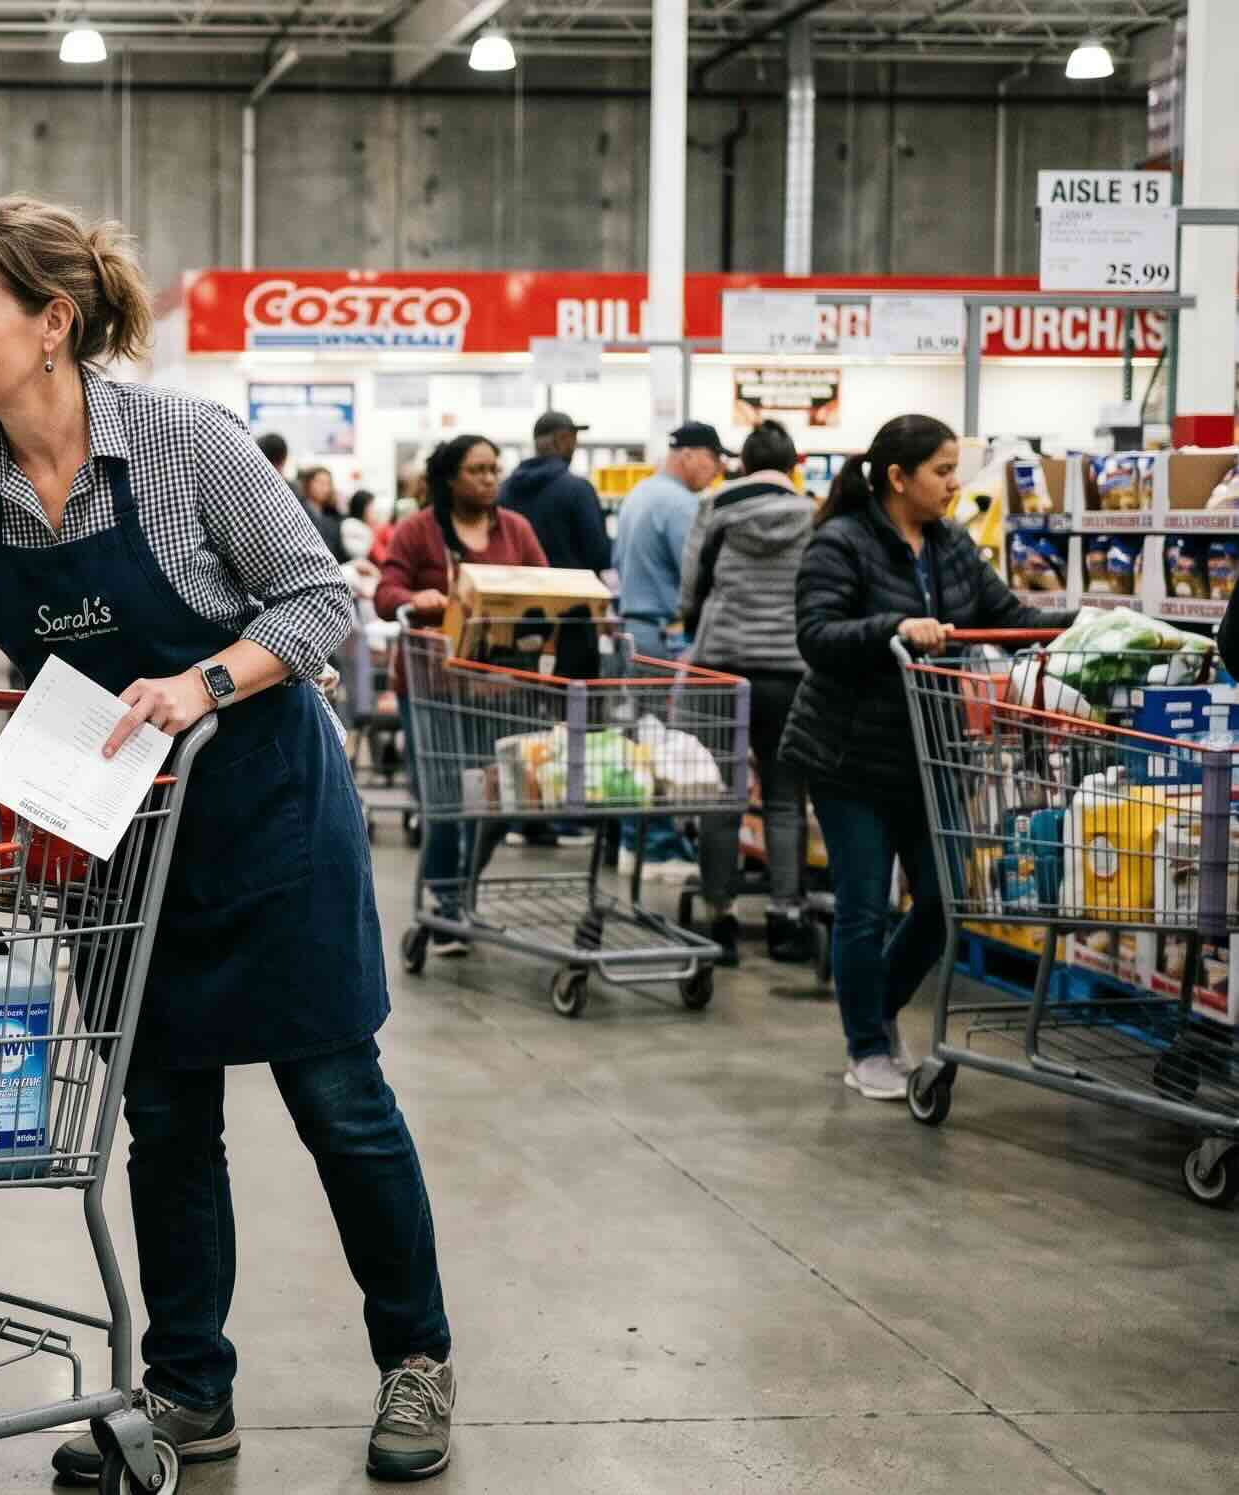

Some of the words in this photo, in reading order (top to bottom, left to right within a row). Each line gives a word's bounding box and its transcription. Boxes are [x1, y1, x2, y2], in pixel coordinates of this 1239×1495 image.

[1050, 179, 1123, 204] AISLE
[1132, 179, 1160, 204] 15
[1105, 263, 1170, 285] 25.99
[251, 286, 463, 327] COSTCO
[34, 596, 112, 635] Sarah's
